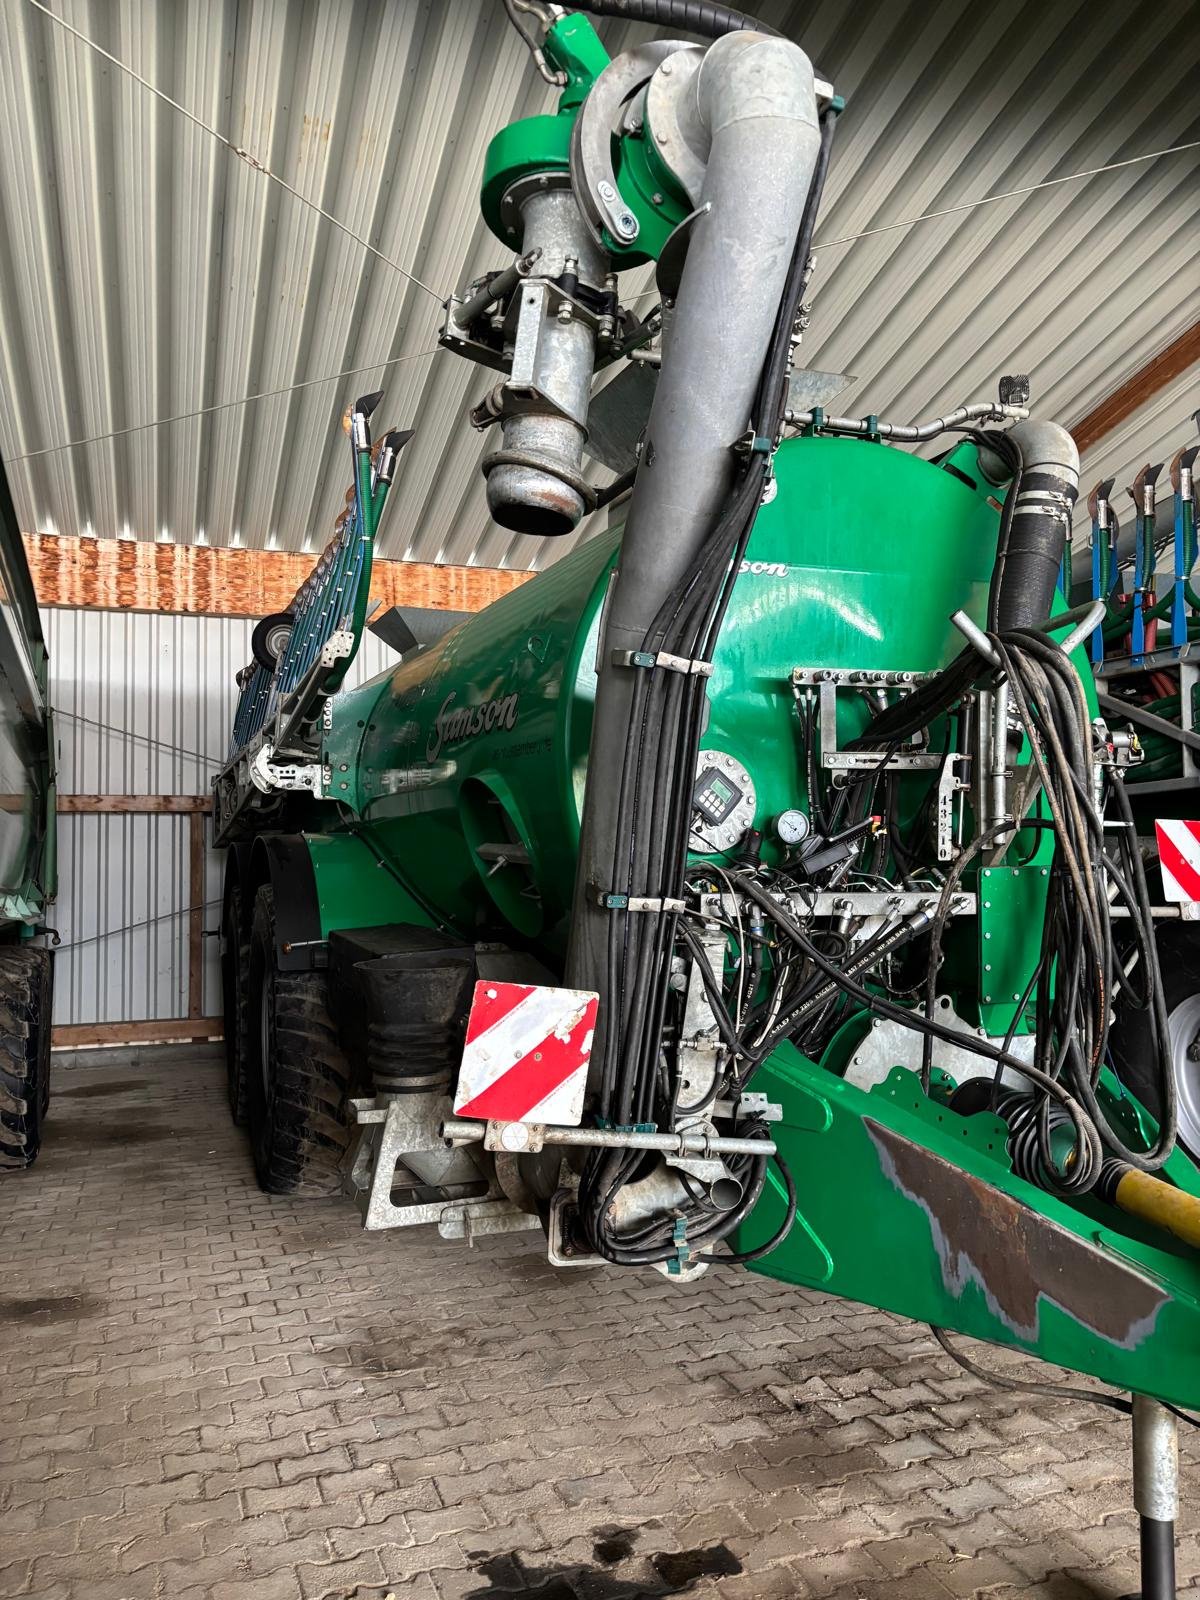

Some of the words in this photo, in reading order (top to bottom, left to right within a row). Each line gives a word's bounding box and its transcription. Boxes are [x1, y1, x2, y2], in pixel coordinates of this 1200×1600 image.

[738, 560, 789, 578] son
[426, 690, 519, 764] Samson
[940, 795, 947, 805] 4
[940, 809, 947, 819] 3
[940, 822, 947, 832] 2
[941, 835, 946, 845] 1
[939, 848, 947, 858] 0
[895, 927, 908, 937] BAR
